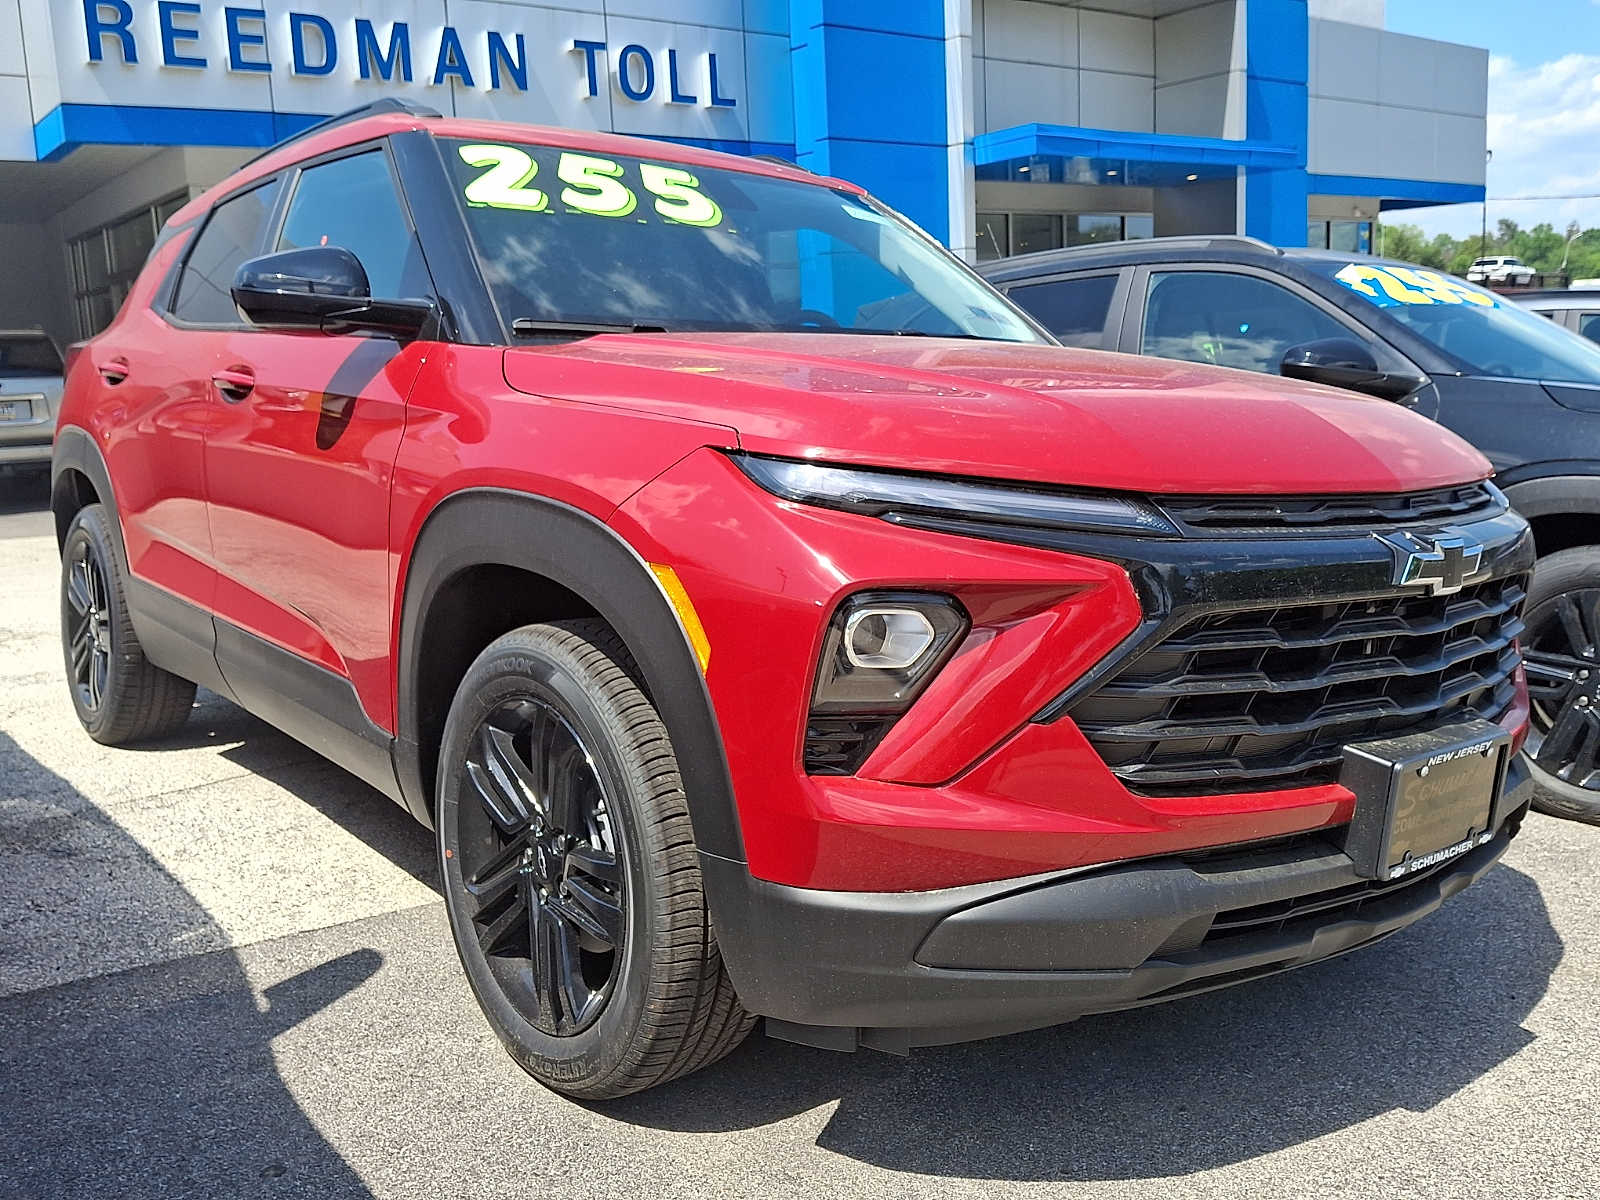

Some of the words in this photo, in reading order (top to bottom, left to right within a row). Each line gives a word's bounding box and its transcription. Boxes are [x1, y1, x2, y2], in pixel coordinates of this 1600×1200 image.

[83, 0, 528, 91] REEDMAN
[573, 39, 737, 107] TOLL
[457, 144, 723, 228] 255
[1428, 753, 1453, 767] NEW
[1454, 740, 1492, 759] JERSEY
[1410, 840, 1473, 872] SCHUMACHER
